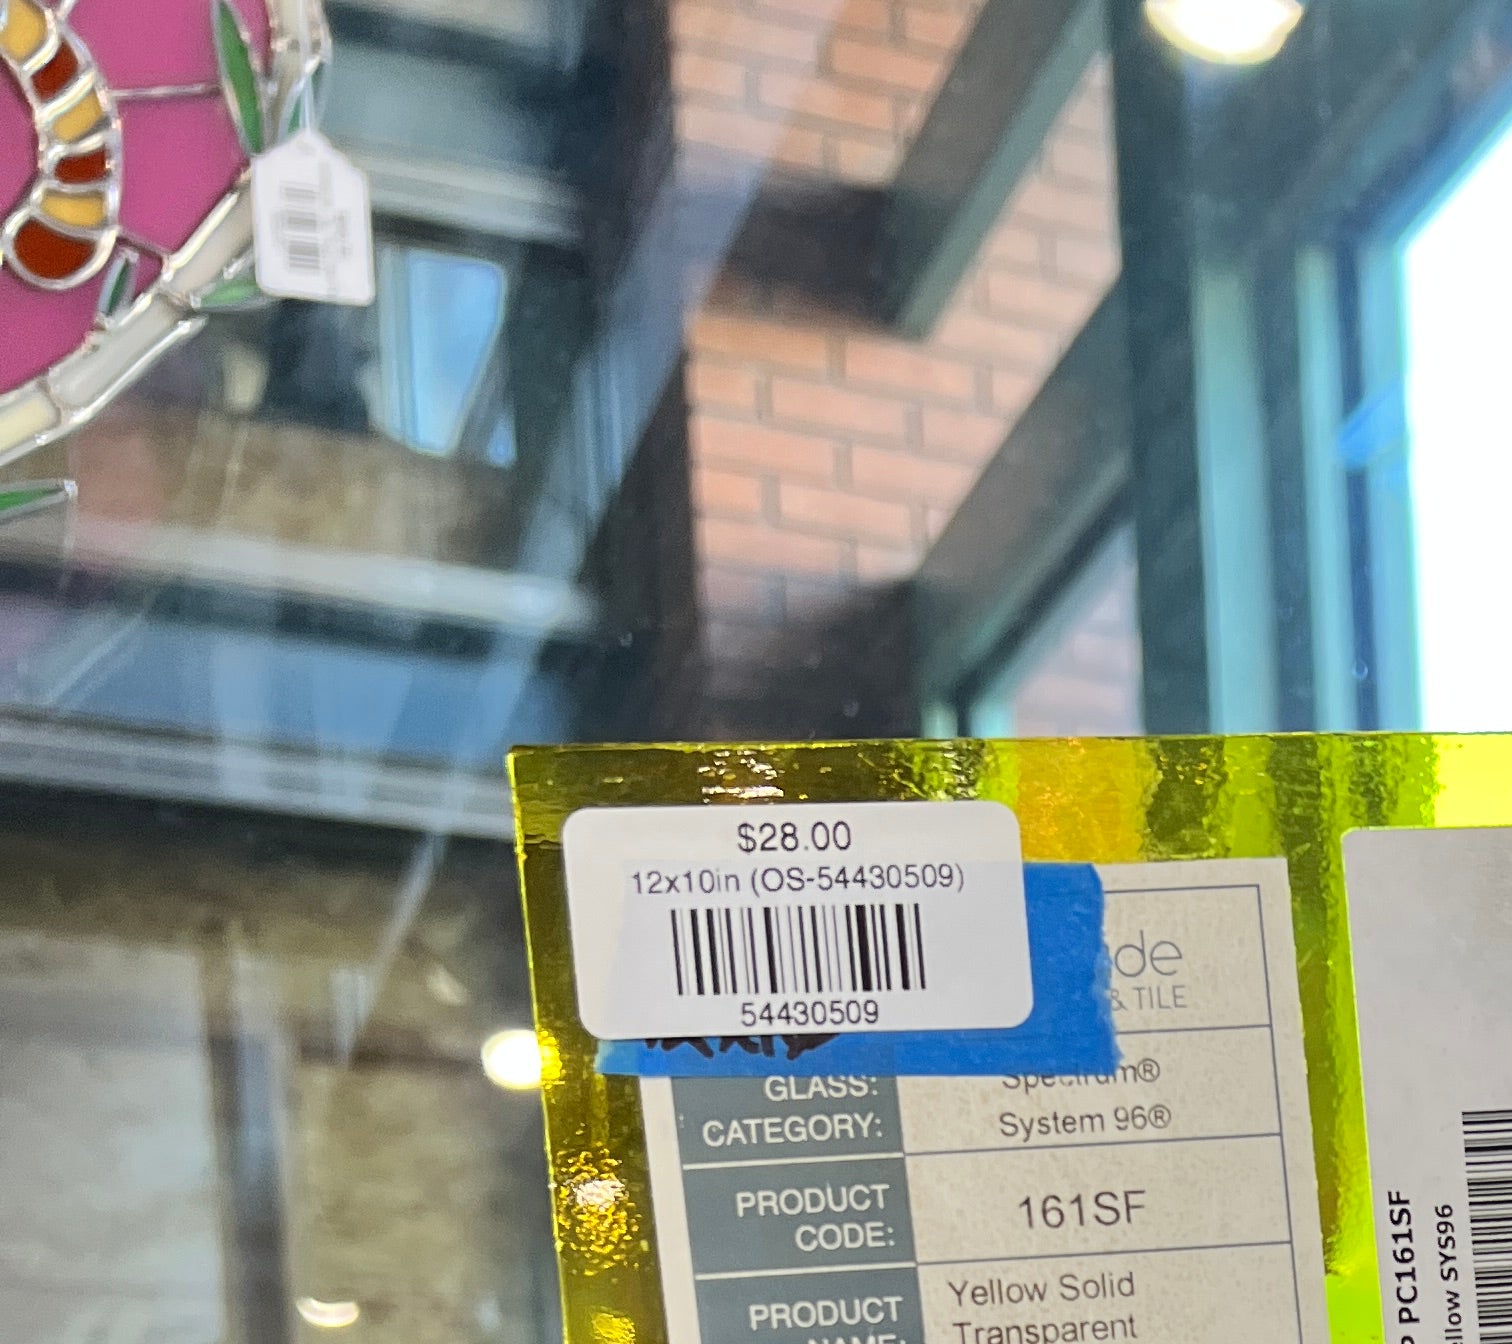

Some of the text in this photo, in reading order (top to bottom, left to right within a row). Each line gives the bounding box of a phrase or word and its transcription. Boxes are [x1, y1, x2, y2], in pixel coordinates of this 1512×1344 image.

[737, 820, 852, 853] $28.00
[631, 862, 965, 898] 12x10in (OS-54430509)
[1104, 928, 1183, 979] de
[740, 999, 880, 1027] 54430509
[1131, 984, 1189, 1011] TILE
[764, 1075, 879, 1102] GLASS:
[702, 1112, 883, 1148] CATEGORY:
[999, 1110, 1105, 1143] System
[735, 1183, 890, 1218] PRODUCT
[1018, 1189, 1147, 1230] 161SF
[794, 1222, 896, 1252] CODE:
[1434, 1203, 1459, 1283] SYS96
[1387, 1190, 1421, 1324] PC161SF
[947, 1270, 1136, 1308] Yellow Solid
[749, 1296, 903, 1332] PRODUCT
